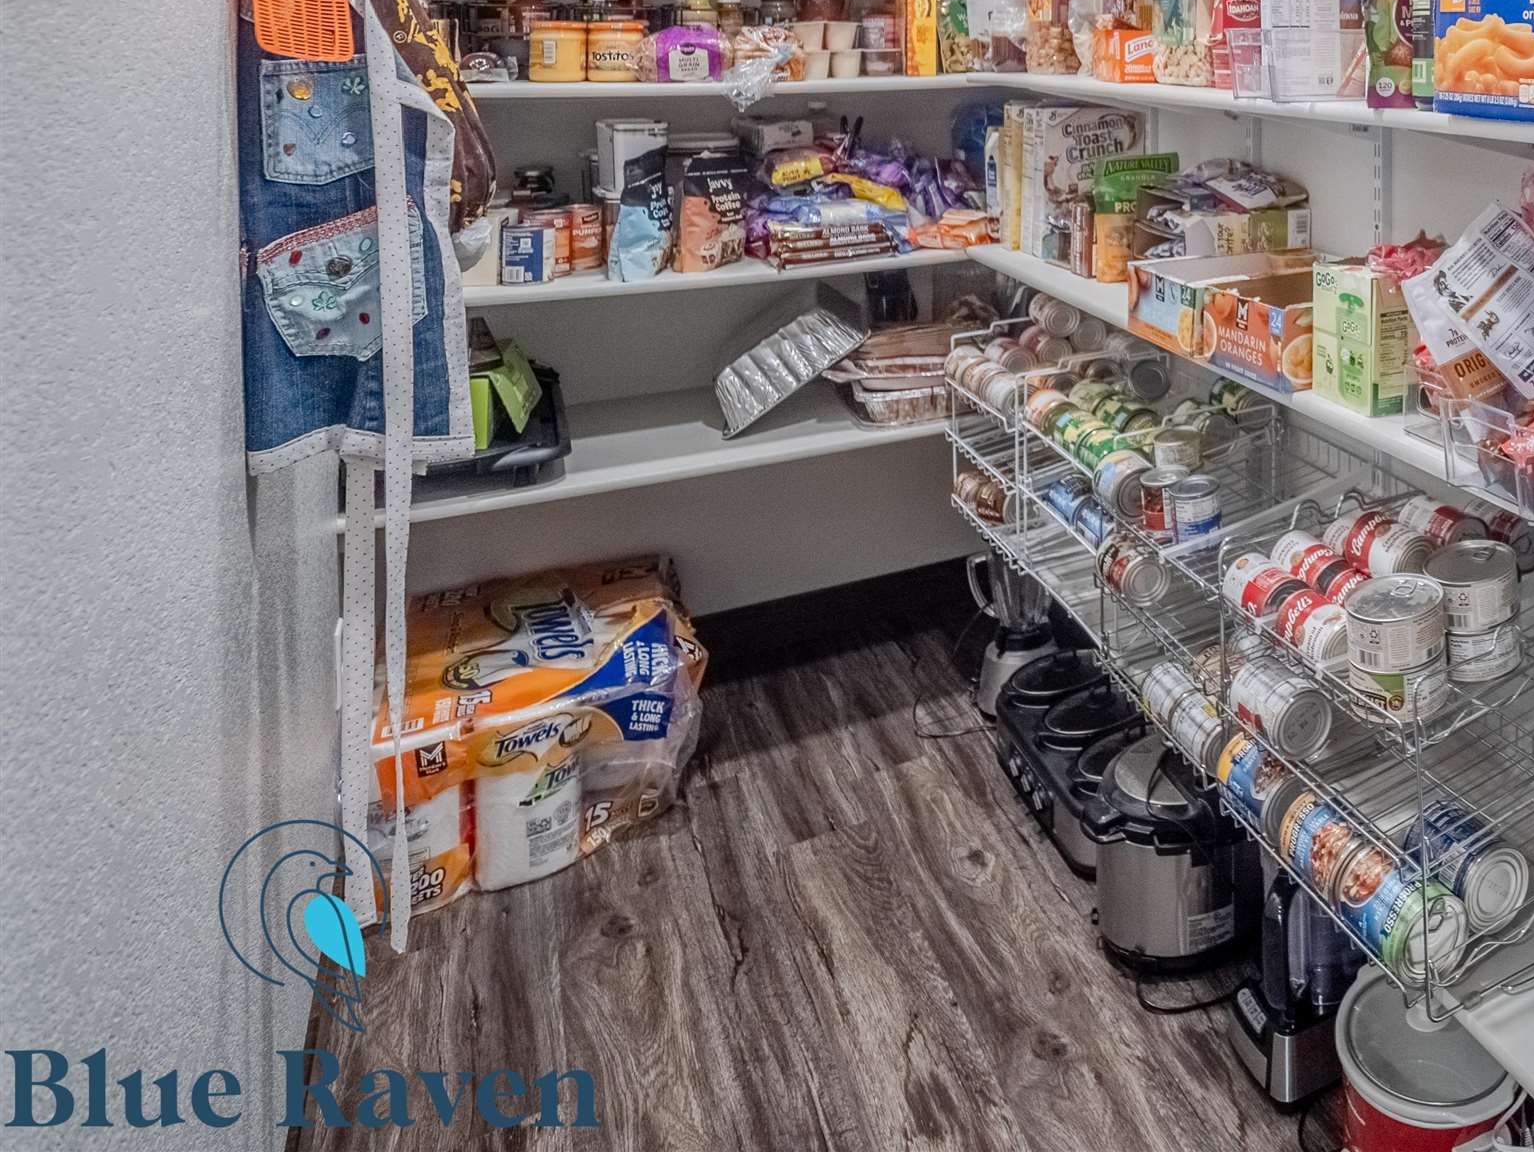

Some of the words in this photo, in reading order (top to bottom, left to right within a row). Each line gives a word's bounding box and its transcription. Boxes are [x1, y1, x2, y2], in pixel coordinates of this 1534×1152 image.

[1228, 0, 1259, 15] IDAHOAN
[592, 50, 635, 61] Tostitos
[1127, 39, 1153, 55] Lanc
[1062, 117, 1125, 137] Cinnamon
[1073, 129, 1112, 147] Toast
[1066, 138, 1124, 164] Crunch
[1104, 159, 1139, 176] NATURE
[1140, 156, 1172, 172] VALLEY
[711, 192, 741, 204] Protein
[715, 201, 741, 212] Coffee
[573, 227, 602, 237] PUMPK
[823, 226, 850, 236] ALMOND
[850, 224, 869, 233] BARK
[1315, 271, 1335, 287] GoGo
[1271, 312, 1282, 329] 24
[1342, 320, 1360, 334] GoGo
[1218, 326, 1266, 353] MANDARIN
[1447, 328, 1459, 337] 7g
[1446, 335, 1469, 348] PROTEI
[1220, 340, 1264, 367] ORANGES
[1454, 353, 1486, 378] ORIG
[1284, 595, 1313, 641] mpbell's
[637, 647, 650, 676] LONG
[631, 699, 665, 714] THICK
[631, 712, 639, 721] &
[640, 713, 662, 723] LONG
[628, 721, 660, 732] LASTING
[494, 722, 562, 759] Towels
[544, 755, 580, 789] Tow
[584, 802, 612, 830] 15
[1289, 803, 1315, 858] PROGRESSO
[409, 884, 443, 905] EETS
[1384, 881, 1422, 933] PROGRESSO
